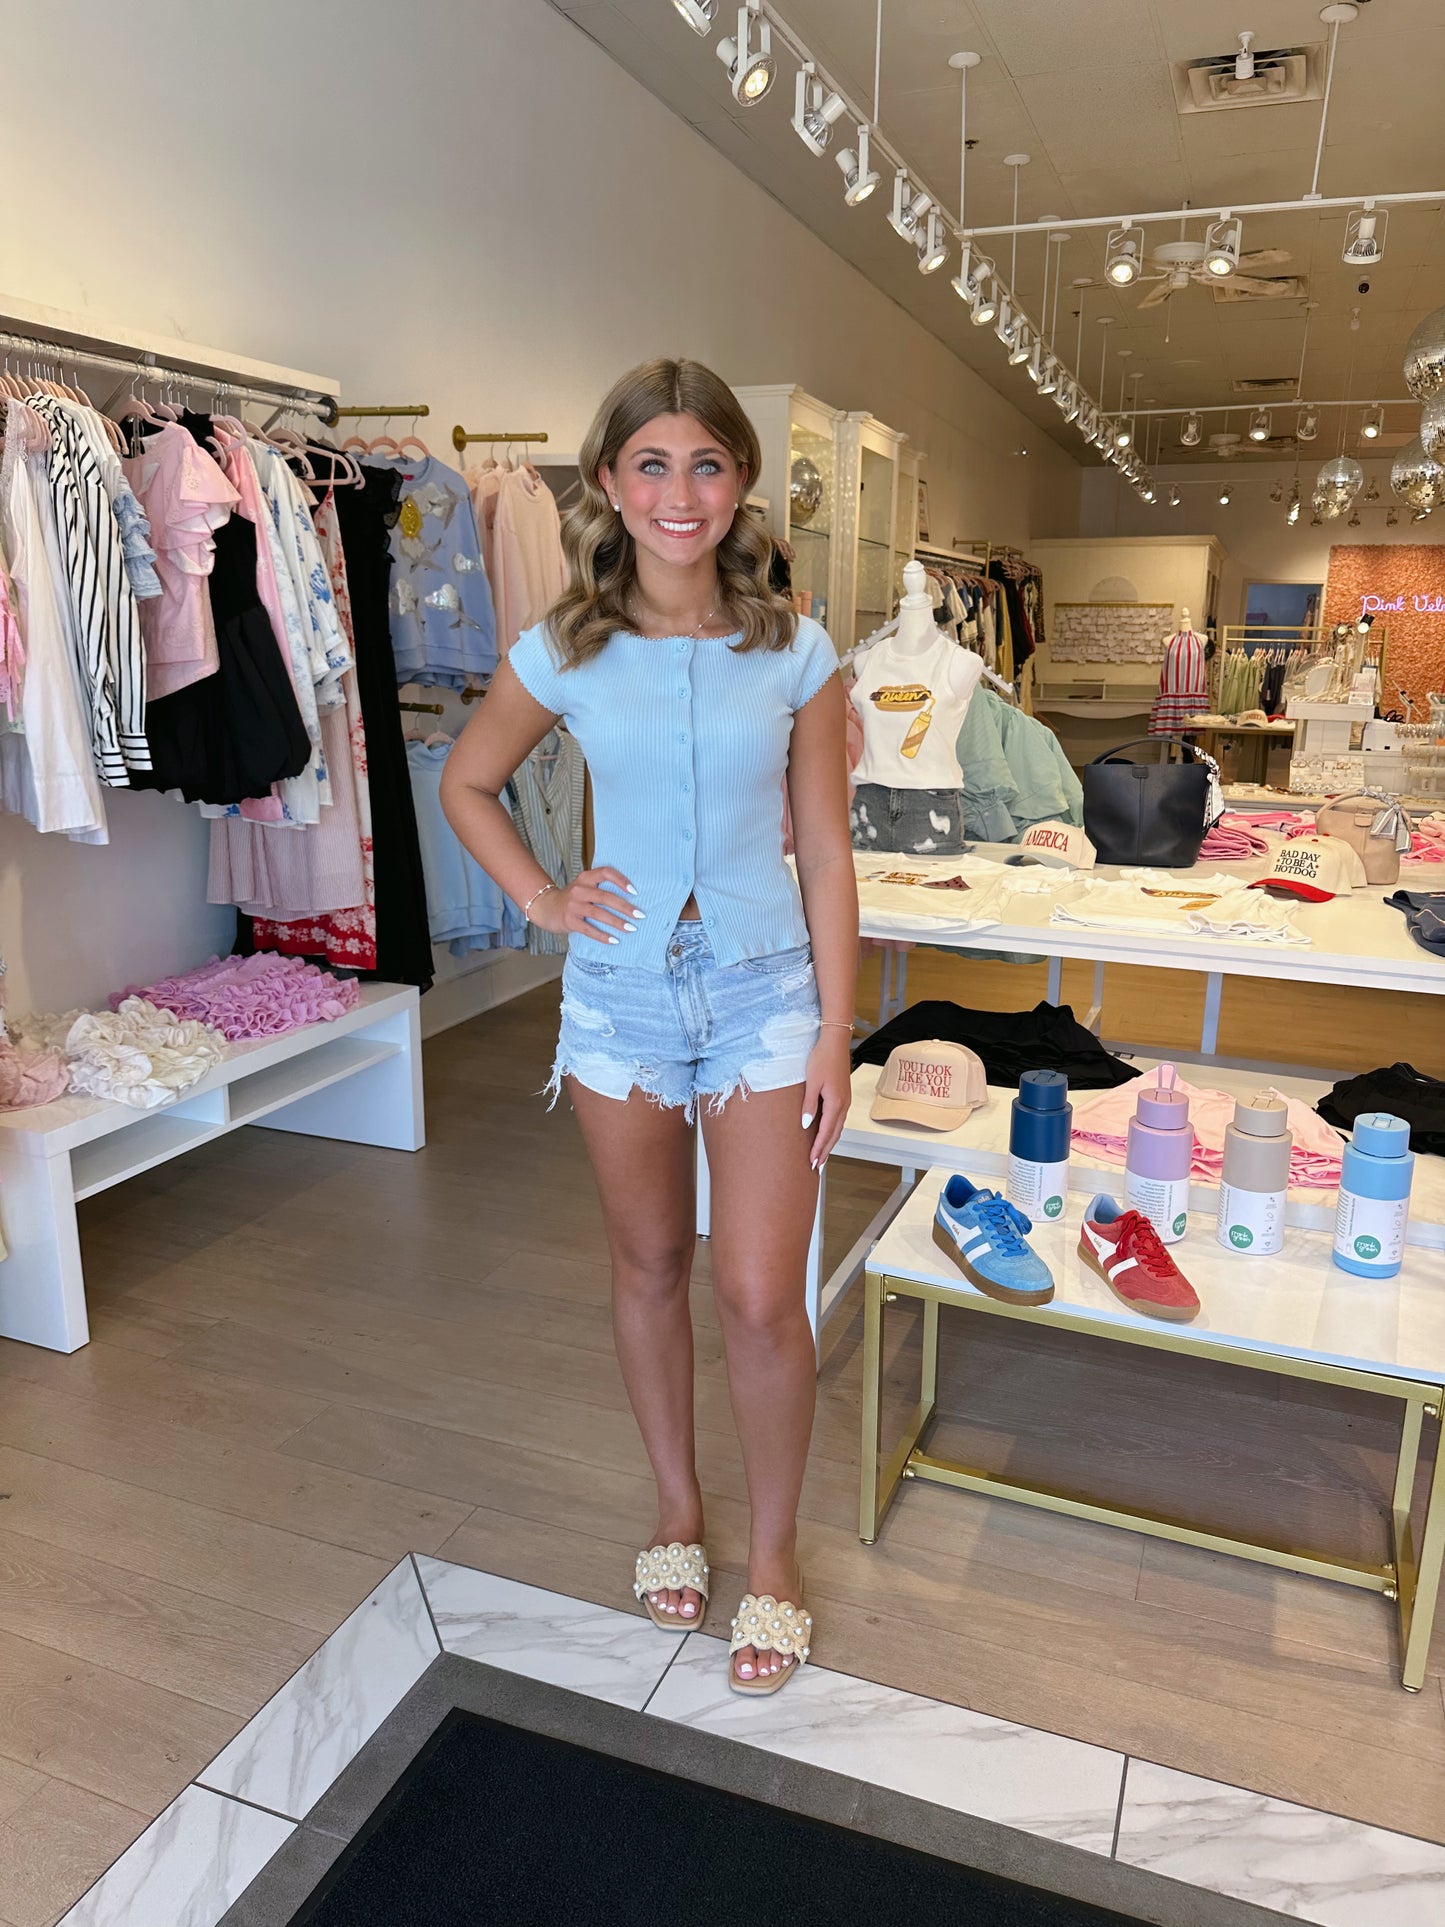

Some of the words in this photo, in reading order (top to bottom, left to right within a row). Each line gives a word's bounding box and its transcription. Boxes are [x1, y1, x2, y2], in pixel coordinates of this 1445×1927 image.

[1360, 594, 1405, 616] Pink
[1280, 849, 1299, 859] BAD
[1301, 851, 1321, 863] DAY
[1281, 857, 1292, 866] TO
[1293, 859, 1306, 868] BE
[1306, 862, 1314, 870] A
[898, 1058, 918, 1072] YOU
[920, 1063, 952, 1077] LOOK
[898, 1070, 923, 1084] LIKE
[925, 1074, 952, 1087] YOU
[896, 1081, 927, 1095] LOVE
[930, 1085, 950, 1099] ME
